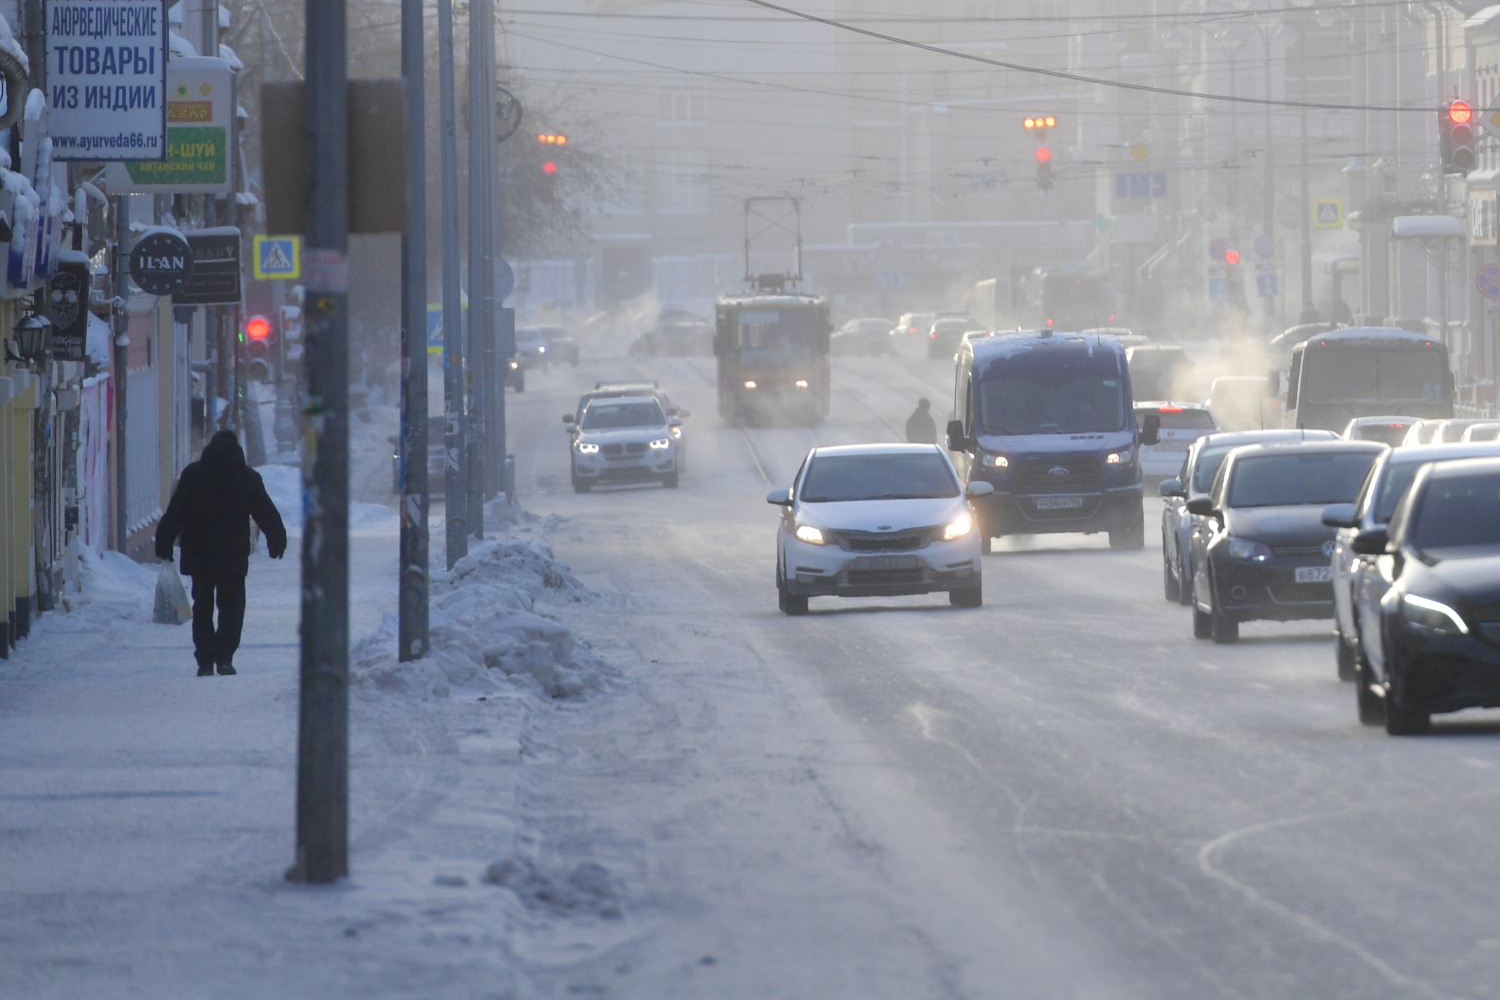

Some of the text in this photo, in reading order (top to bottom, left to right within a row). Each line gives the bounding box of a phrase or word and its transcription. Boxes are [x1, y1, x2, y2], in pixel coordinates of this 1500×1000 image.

[52, 6, 157, 37] АЮРВЕДИЧЕСКИЕ
[55, 46, 155, 75] ТОВАРЫ
[53, 85, 156, 111] ИЗ ИНДИИ
[52, 133, 158, 150] www.ayurveda66.ru
[197, 161, 216, 171] ЧАЙ
[139, 256, 184, 270] ILAN
